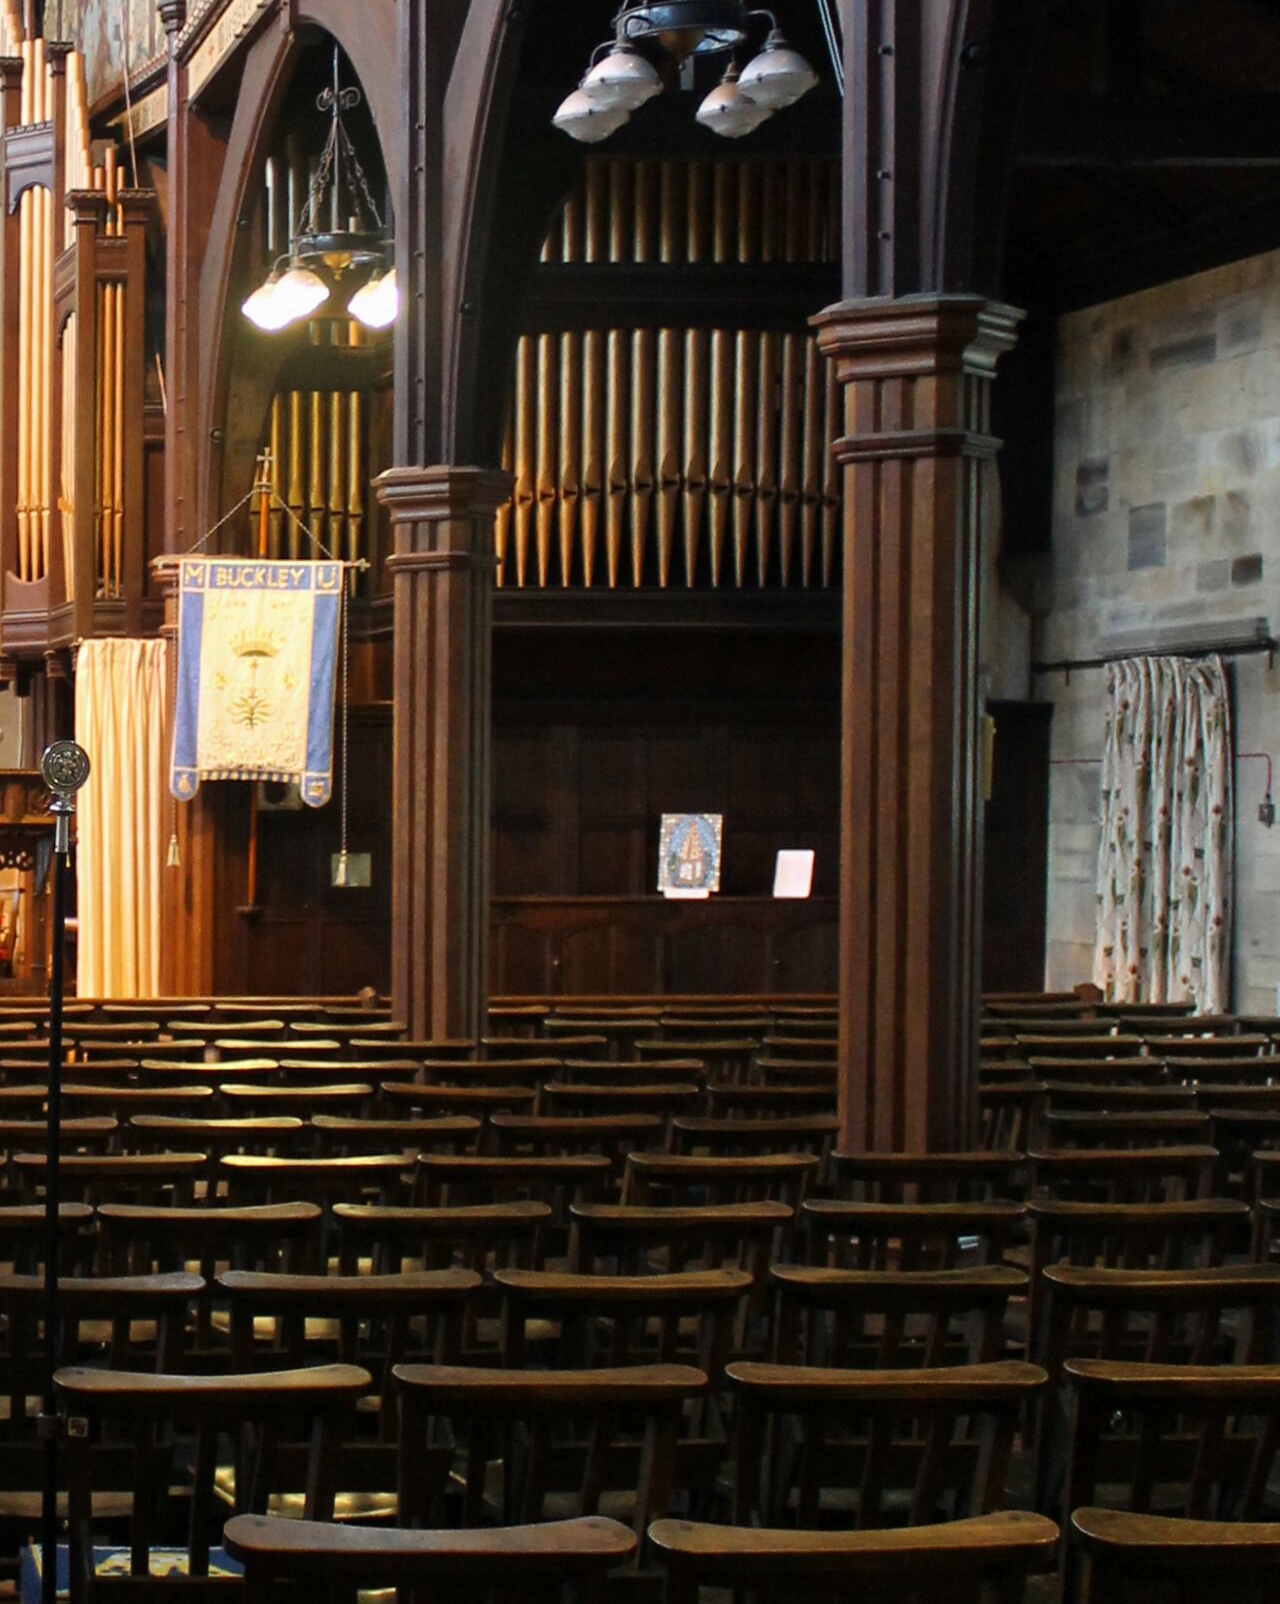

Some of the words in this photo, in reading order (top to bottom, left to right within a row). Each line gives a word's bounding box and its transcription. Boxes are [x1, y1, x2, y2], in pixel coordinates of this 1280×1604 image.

[184, 564, 204, 586] M
[216, 567, 305, 588] BUCKLEY
[317, 567, 337, 589] U
